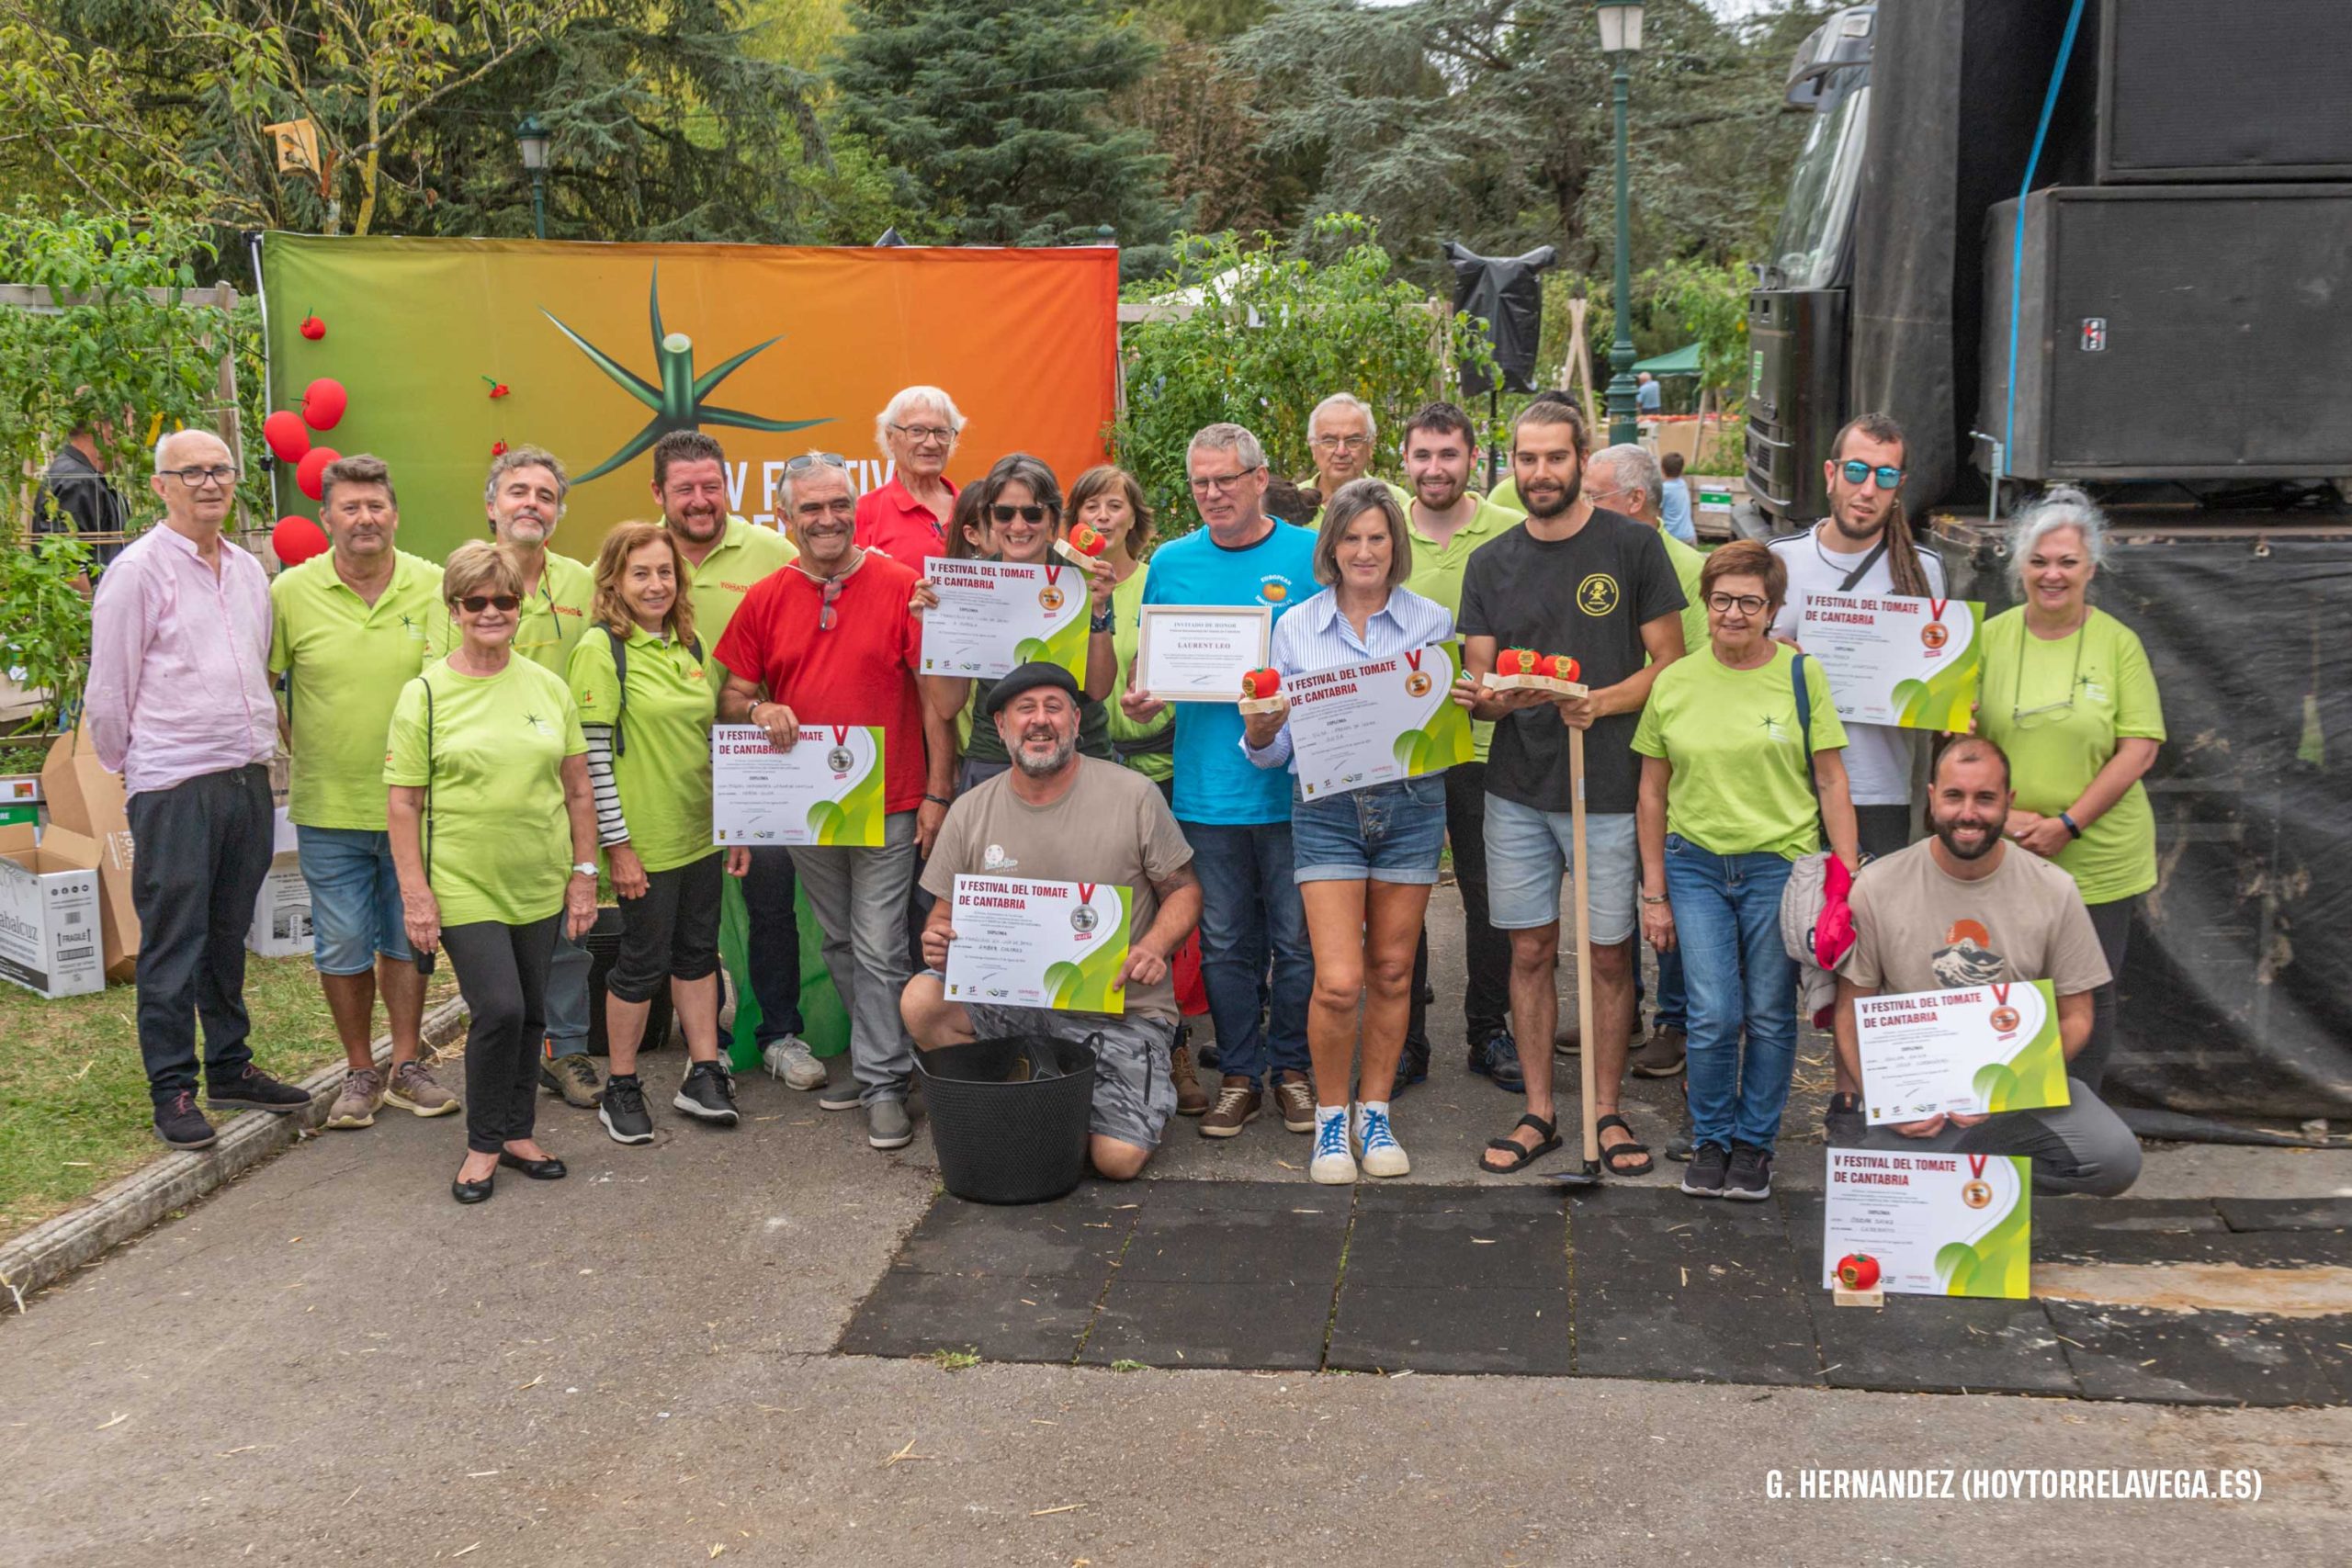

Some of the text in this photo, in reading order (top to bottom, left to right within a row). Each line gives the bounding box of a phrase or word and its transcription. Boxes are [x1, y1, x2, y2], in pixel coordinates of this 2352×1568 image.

[931, 563, 1035, 579] V FESTIVAL DEL TOMATE
[931, 576, 994, 590] DE CANTABRIA
[1806, 595, 1919, 614] V FESTIVAL DEL TOMATE
[1805, 611, 1874, 626] DE CANTABRIA
[1287, 660, 1396, 693] V FESTIVAL DEL TOMATE
[1291, 682, 1358, 706] DE CANTABRIA
[719, 731, 823, 741] V FESTIVAL MATE
[719, 745, 730, 754] DE
[960, 881, 1069, 898] V FESTIVAL DEL TOMATE
[959, 896, 1025, 910] DE CANTABRIA
[62, 932, 86, 942] FRAGILE
[1861, 992, 1982, 1013] V FESTIVAL DEL TOMATE
[1864, 1012, 1938, 1028] DE CANTABRIA
[1834, 1156, 1957, 1171] V FESTIVAL DEL TOMATE
[1834, 1172, 1909, 1186] DE CANTABRIA
